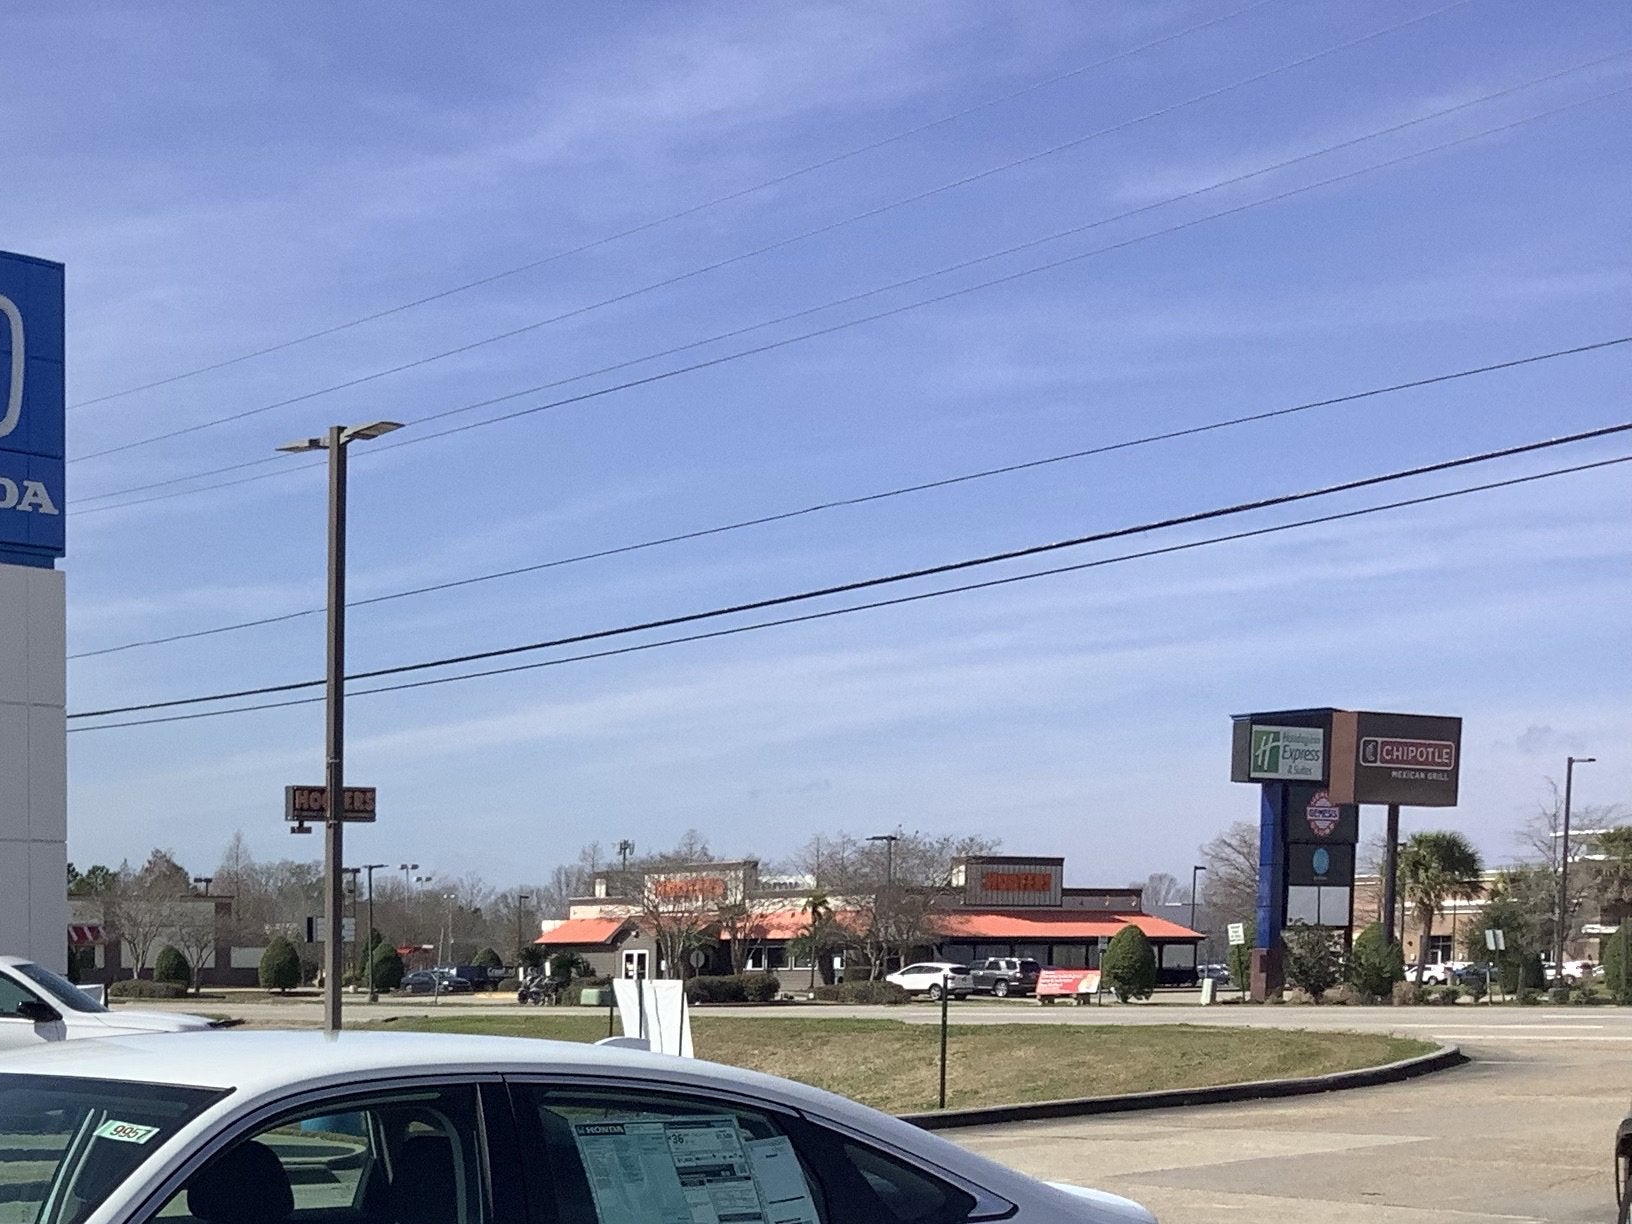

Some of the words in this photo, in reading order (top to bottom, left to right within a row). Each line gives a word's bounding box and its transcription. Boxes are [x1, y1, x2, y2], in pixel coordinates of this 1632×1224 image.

[1282, 744, 1321, 763] Express
[1382, 745, 1451, 763] CHIPOTLE
[1391, 771, 1426, 780] MEXICAN
[1427, 772, 1449, 781] GRILL
[295, 790, 375, 810] HOOERS
[110, 1125, 152, 1140] 9957
[586, 1125, 624, 1134] HONDA
